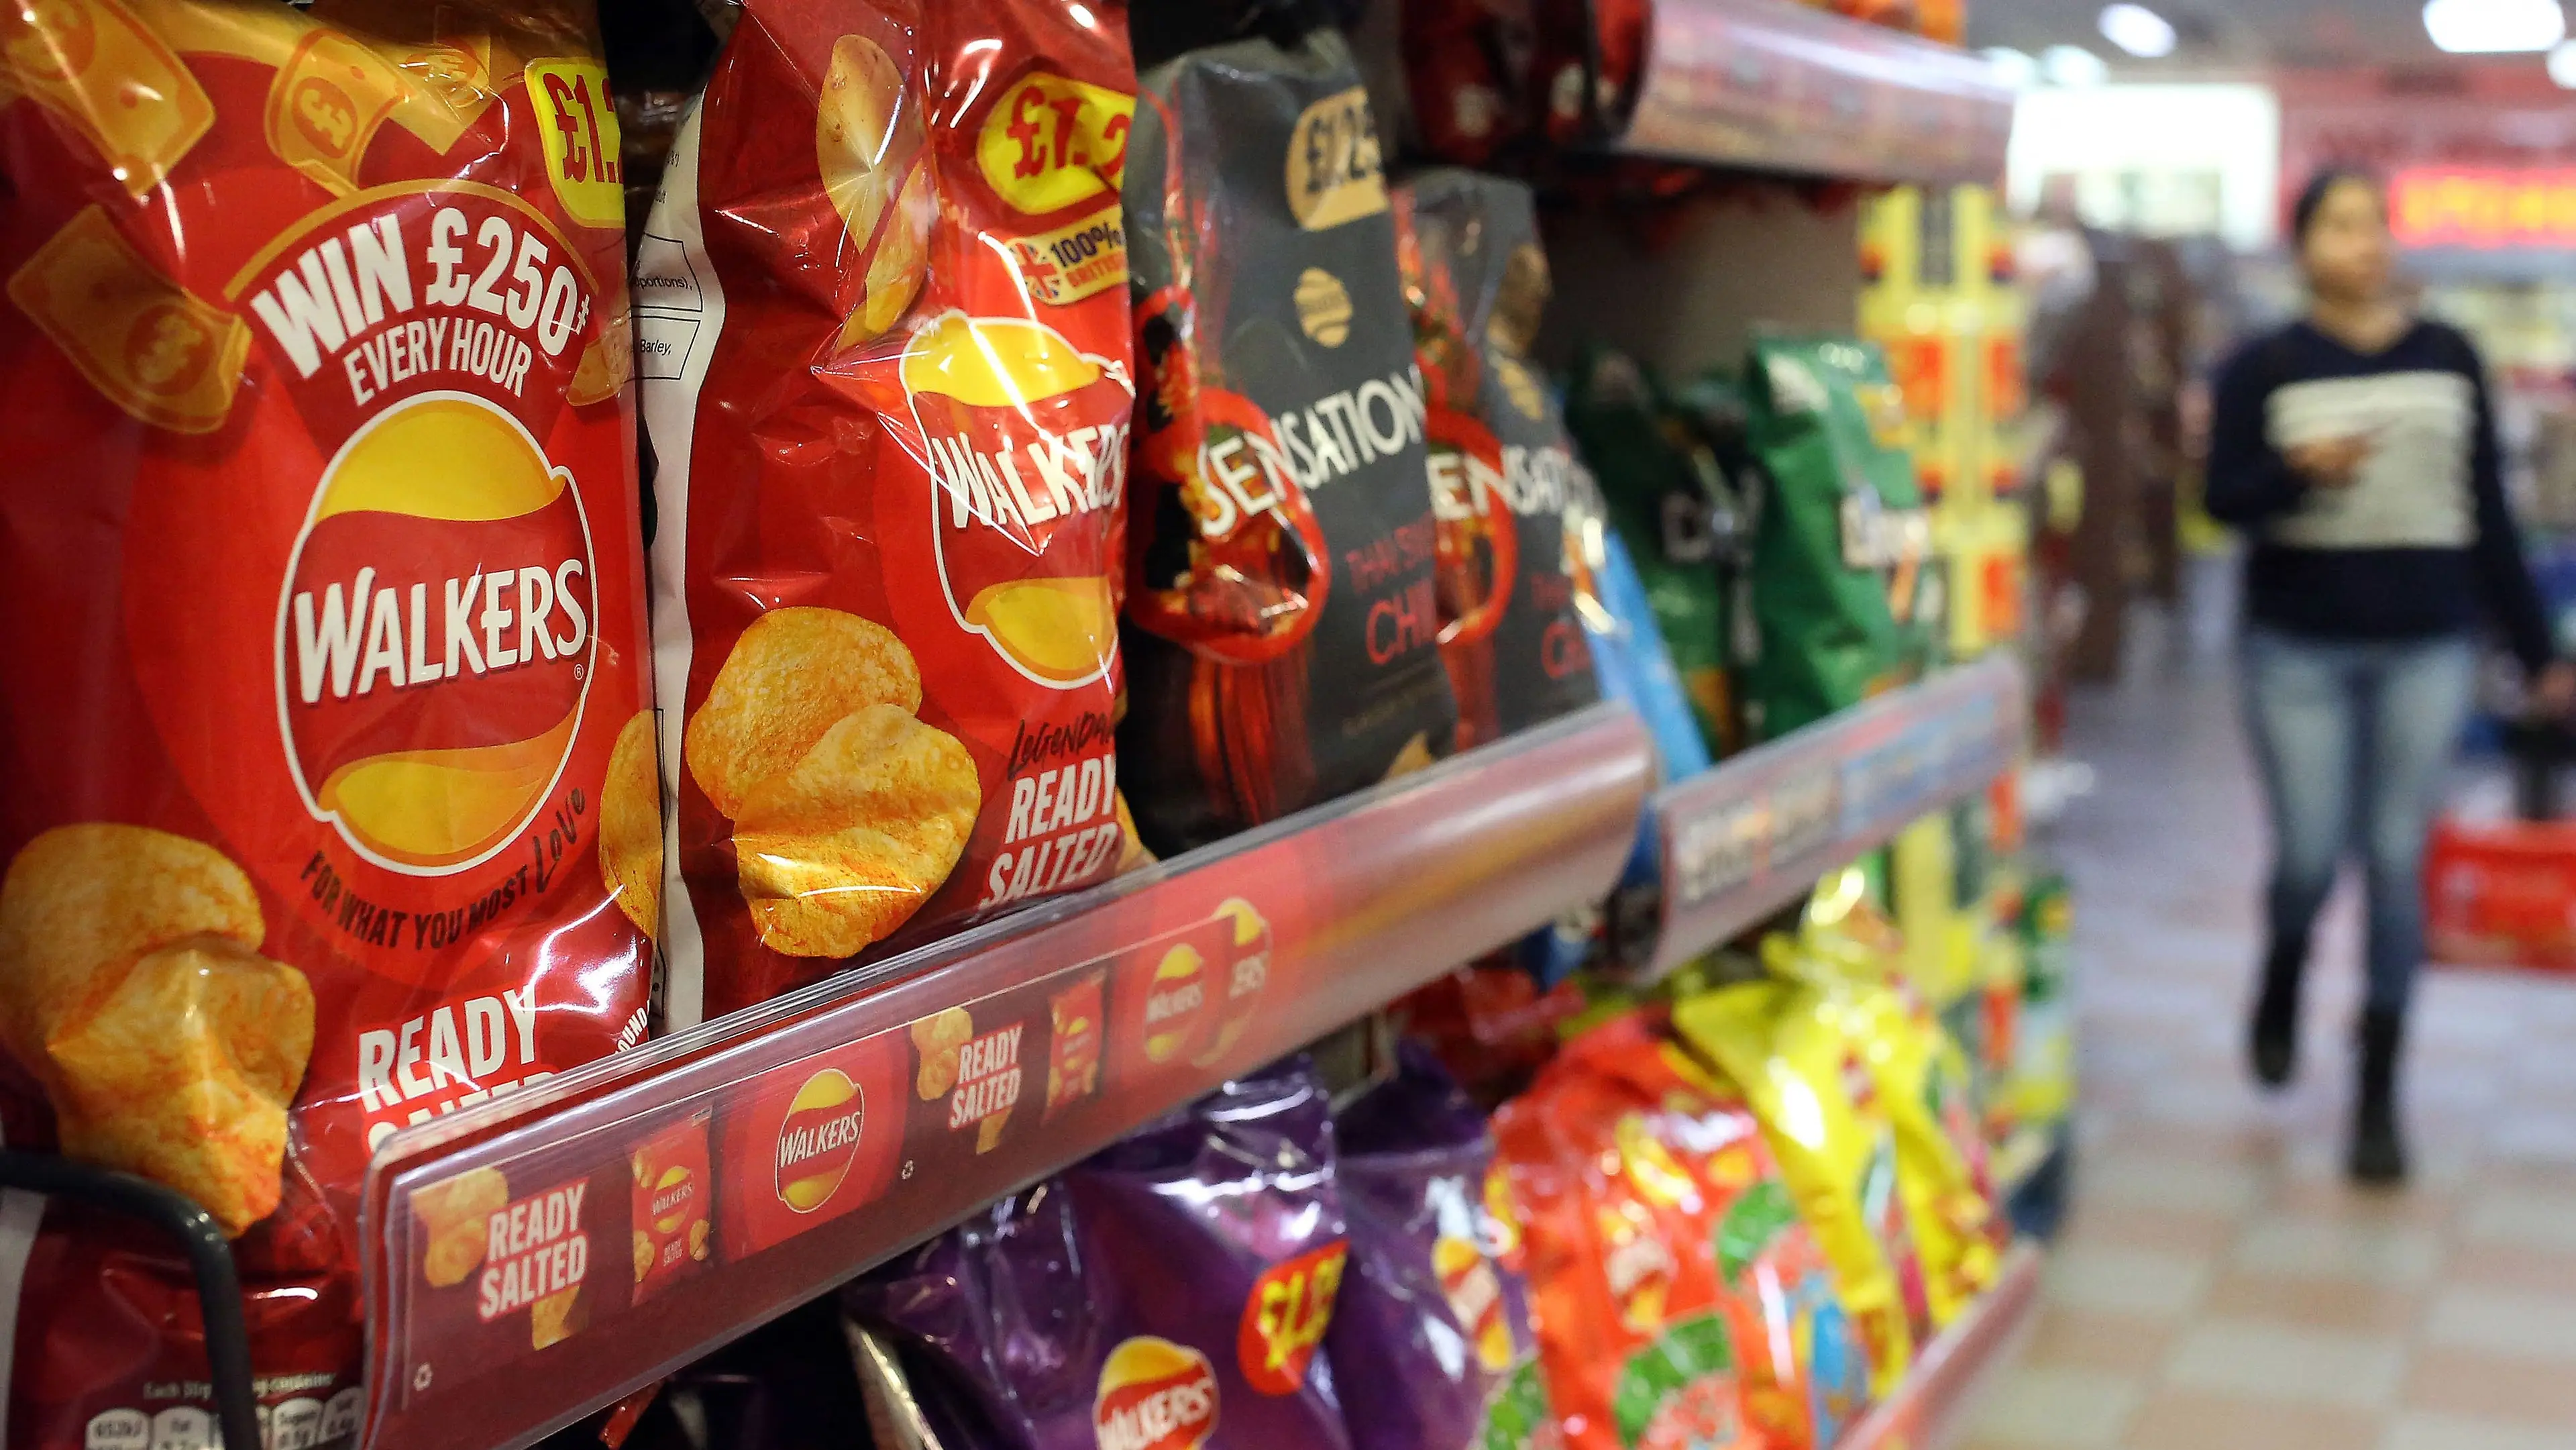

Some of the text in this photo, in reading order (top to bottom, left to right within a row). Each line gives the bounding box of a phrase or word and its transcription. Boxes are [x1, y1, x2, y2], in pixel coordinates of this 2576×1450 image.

[1051, 220, 1122, 268] 100%
[252, 214, 414, 379] WIN
[343, 317, 533, 407] EVERY HOUR
[639, 338, 672, 356] Barley,
[294, 558, 587, 705] WALKERS
[1005, 753, 1116, 844] READY
[301, 850, 341, 916] FOR
[337, 888, 408, 948] WHAT
[414, 907, 463, 951] YOU
[467, 864, 528, 933] MOST
[974, 822, 1118, 913] SALTED
[357, 984, 537, 1114] READY
[957, 1028, 1023, 1084] READY
[780, 1111, 862, 1169] WALKERS
[950, 1066, 1022, 1129] SALTED
[487, 1182, 586, 1262] READY
[479, 1234, 588, 1320] SALTED
